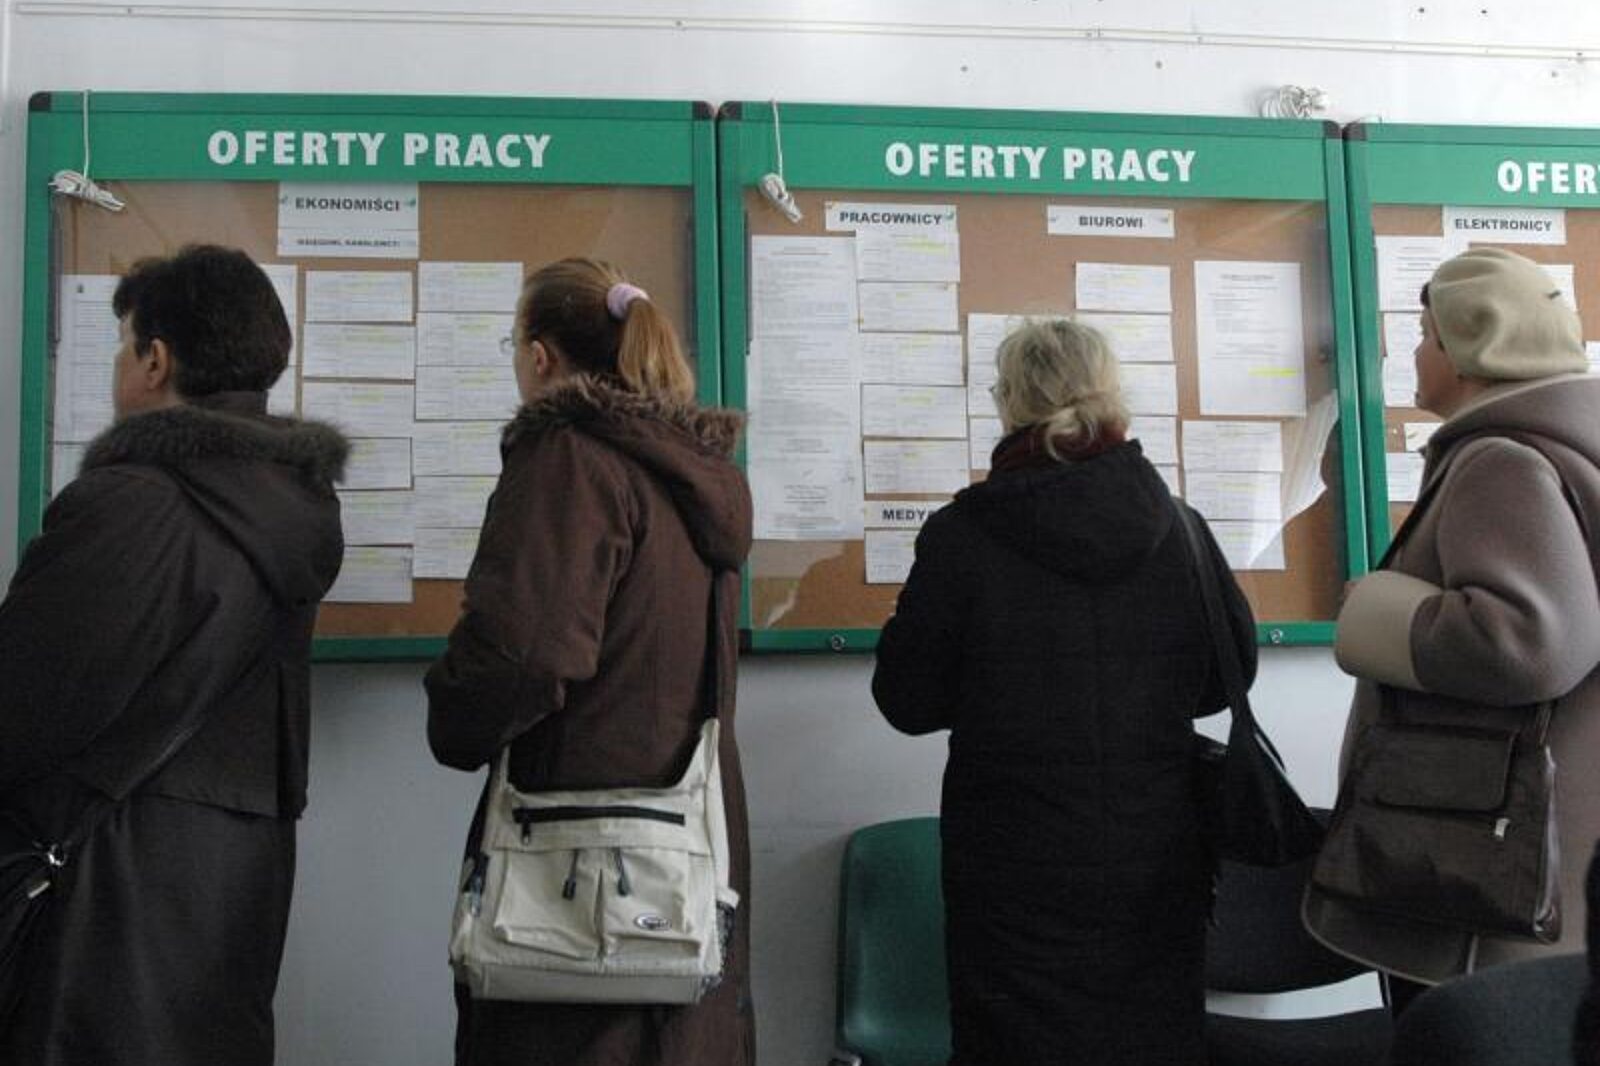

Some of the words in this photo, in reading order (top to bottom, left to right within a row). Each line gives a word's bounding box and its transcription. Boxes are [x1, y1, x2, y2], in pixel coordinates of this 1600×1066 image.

[207, 130, 386, 166] OFERTY
[403, 132, 552, 168] PRACY
[885, 142, 1047, 180] OFERTY
[1062, 147, 1196, 182] PRACY
[1497, 160, 1600, 194] OFER
[295, 196, 400, 212] EKONOMIŚCI
[839, 211, 942, 225] PRACOWNICY
[1078, 215, 1144, 229] BIUROWI
[1454, 218, 1553, 232] ELEKTRONICY
[882, 508, 935, 521] MEDY
